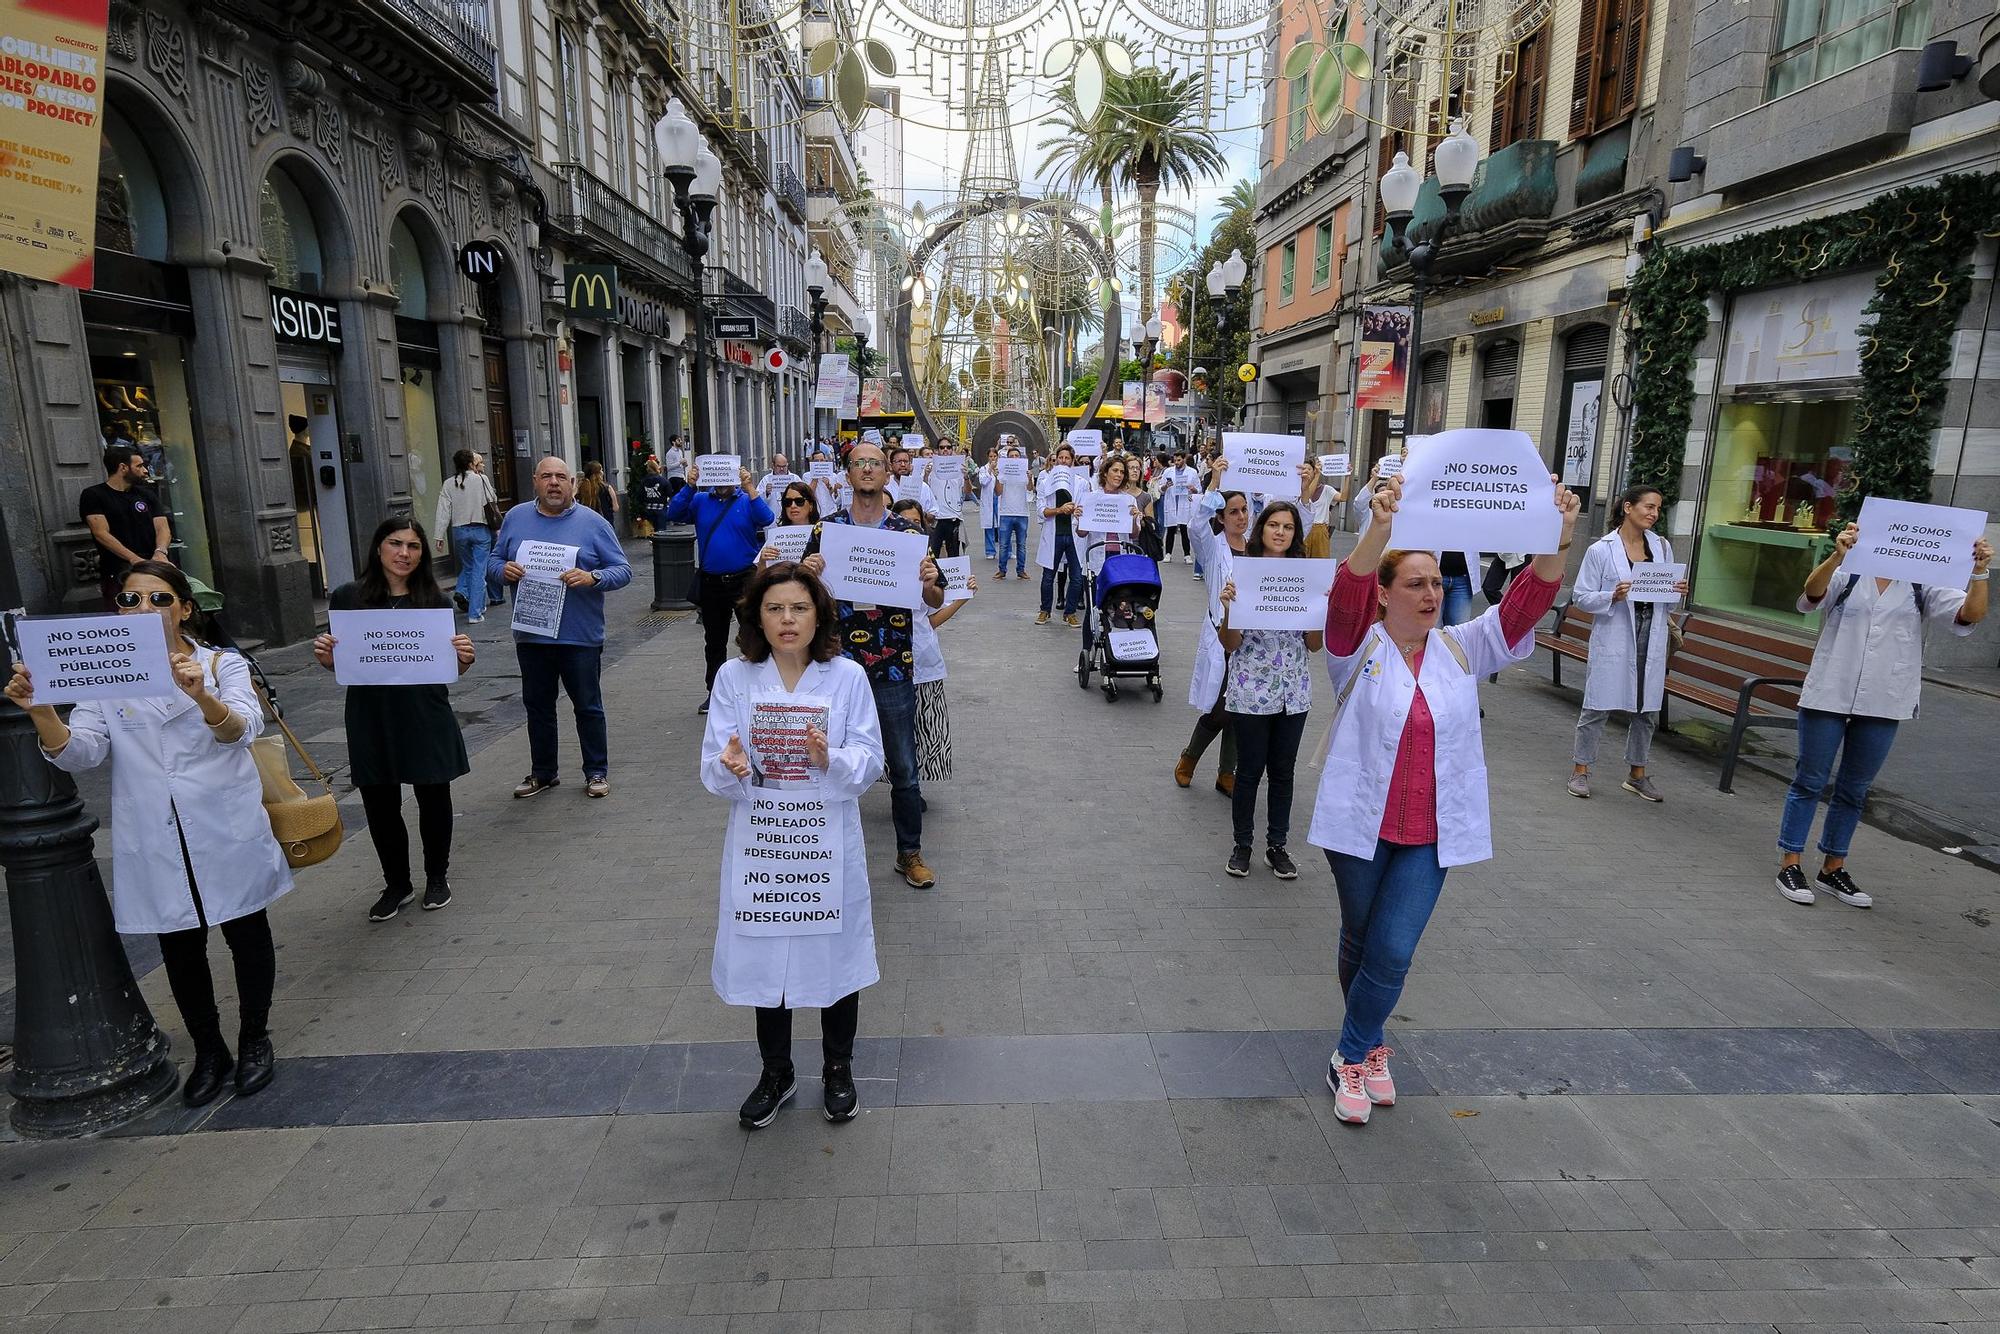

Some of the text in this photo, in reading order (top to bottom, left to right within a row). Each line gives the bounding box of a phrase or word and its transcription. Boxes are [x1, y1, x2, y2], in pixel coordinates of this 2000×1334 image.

[55, 35, 98, 52] CONCIERTOS
[0, 36, 96, 75] OULLINEX
[15, 171, 29, 182] DE
[467, 250, 494, 274] IN
[720, 324, 736, 332] URBAN
[1243, 447, 1285, 457] ¡NO SOMOS
[1247, 456, 1280, 467] MÉDICOS
[1238, 467, 1288, 477] #DESEGUNDA!
[1444, 463, 1518, 476] ¡NO SOMOS
[1431, 480, 1528, 494] ESPECIALISTAS
[1433, 498, 1526, 511] #DESEGUNDA!
[1887, 523, 1952, 538] ¡NO SOMOS
[1890, 535, 1941, 550] MÉDICOS
[850, 546, 896, 557] ¡NO SOMOS
[1873, 547, 1951, 564] #DESEGUNDA!
[848, 555, 896, 568] EMPLEADOS
[852, 565, 891, 577] PÚBLICOS
[843, 575, 897, 588] #DESEGUNDA!
[1261, 576, 1305, 584] ¡NO SOMOS
[1262, 594, 1300, 603] PÚBLICOS
[1255, 605, 1308, 613] #DESEGUNDA!
[47, 627, 130, 644] ¡NO SOMOS
[363, 630, 425, 641] ¡NO SOMOS
[48, 642, 137, 658] EMPLEADOS
[371, 641, 420, 651] MÉDICOS
[359, 654, 434, 663] #DESEGUNDA!
[60, 658, 132, 673] PÚBLICOS
[49, 672, 150, 689] #DESEGUNDA!
[755, 715, 822, 724] MAREA BLANCA
[753, 799, 824, 812] ¡NO SOMOS
[750, 815, 826, 828] EMPLEADOS
[756, 831, 819, 844] PÚBLICOS
[744, 847, 833, 860] #DESEGUNDA!
[744, 871, 831, 886] ¡NO SOMOS
[752, 889, 822, 903] MÉDICOS
[735, 909, 840, 923] #DESEGUNDA!
